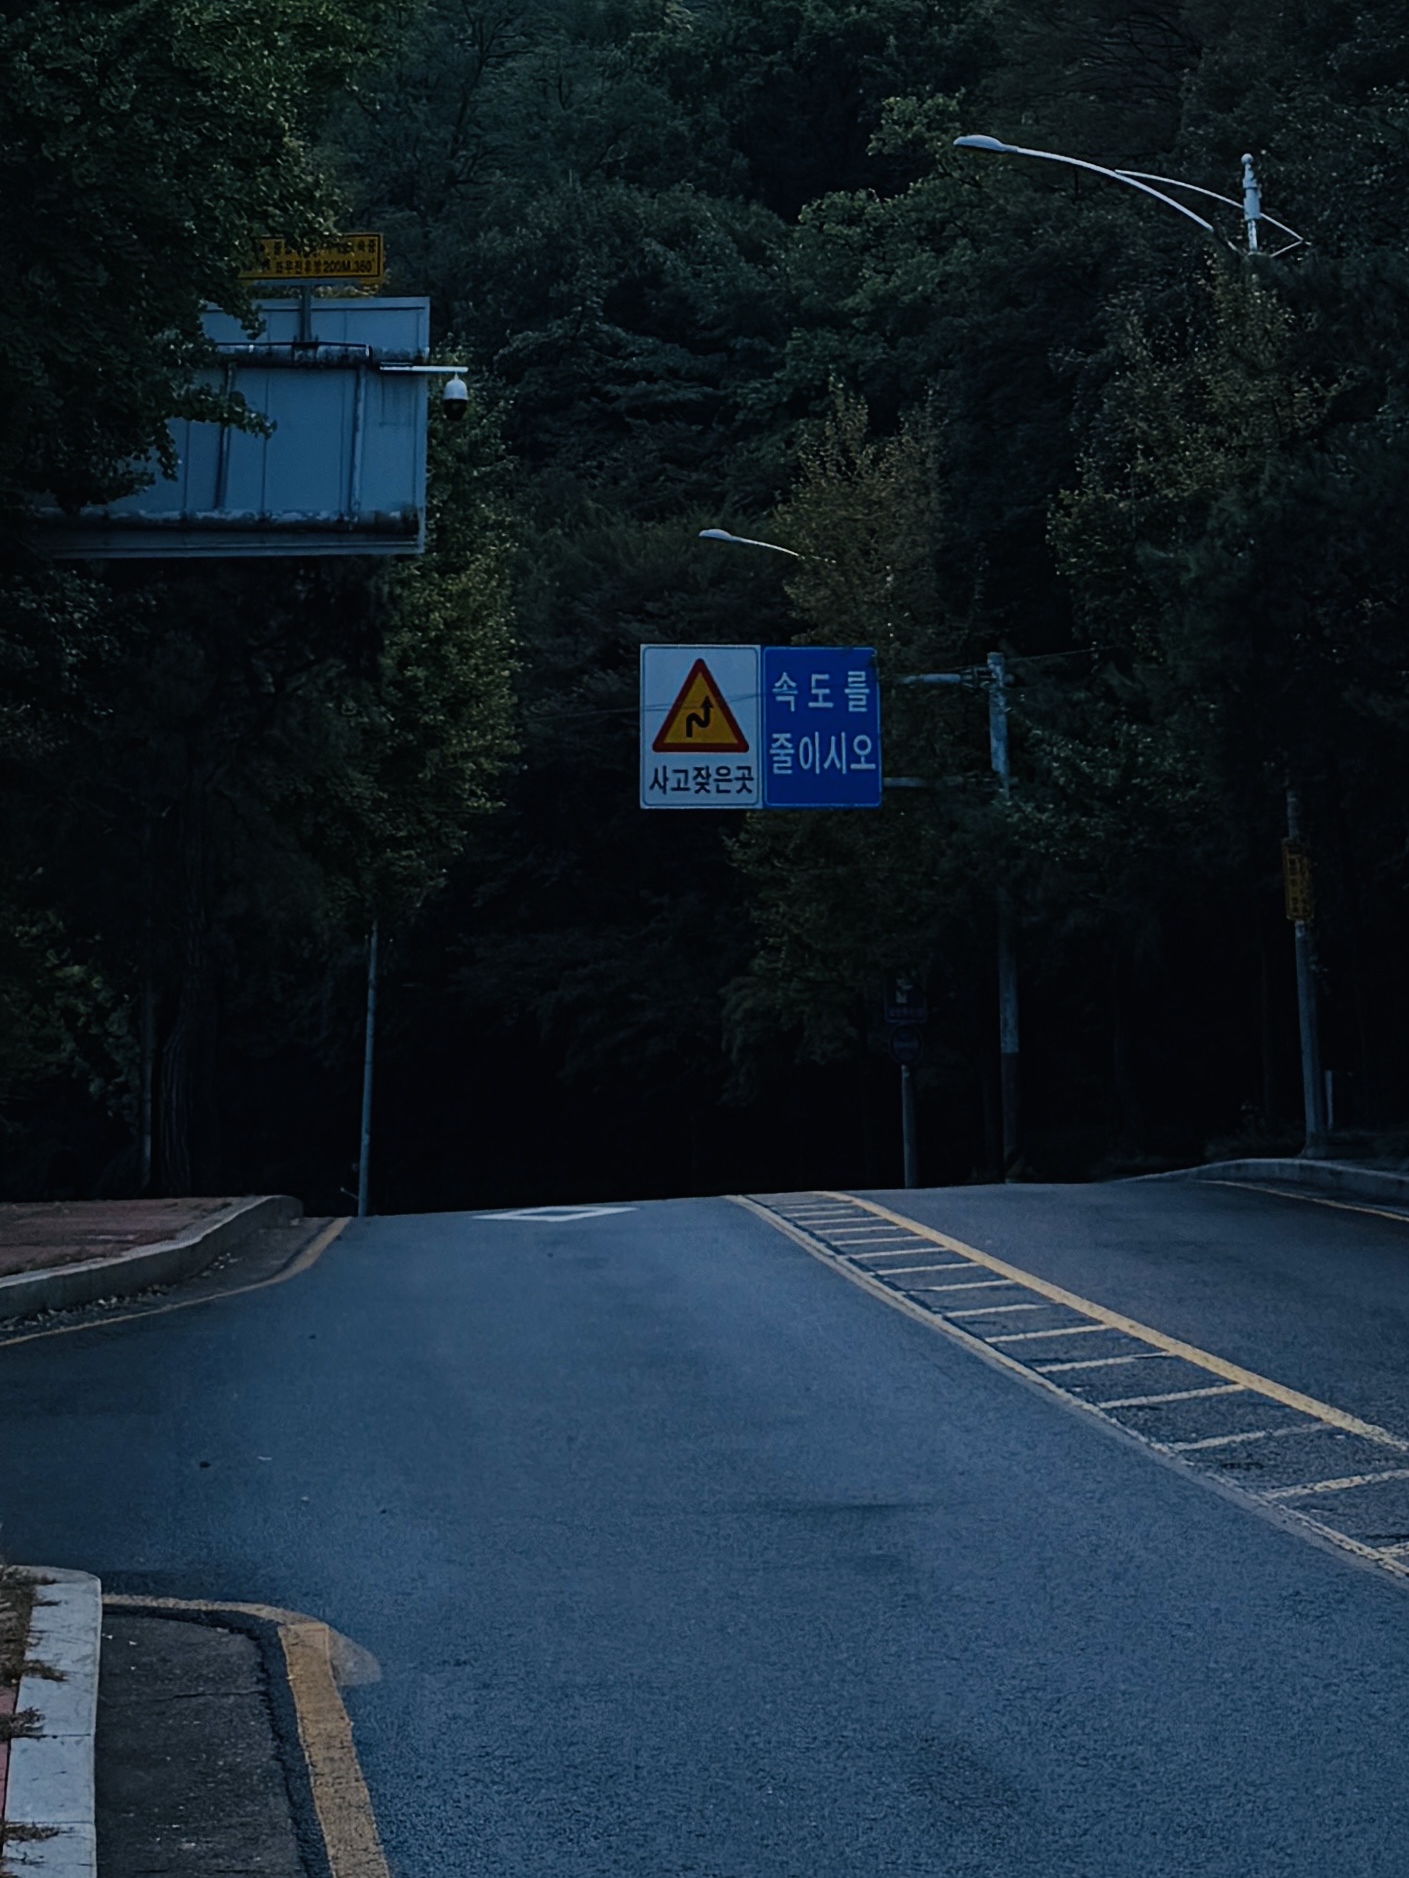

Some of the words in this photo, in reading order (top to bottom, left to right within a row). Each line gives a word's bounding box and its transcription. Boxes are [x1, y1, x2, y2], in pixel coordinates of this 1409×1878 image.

[771, 670, 871, 713] 속도를
[768, 730, 877, 775] 줄이시오
[648, 764, 755, 795] 사고잦은곳
